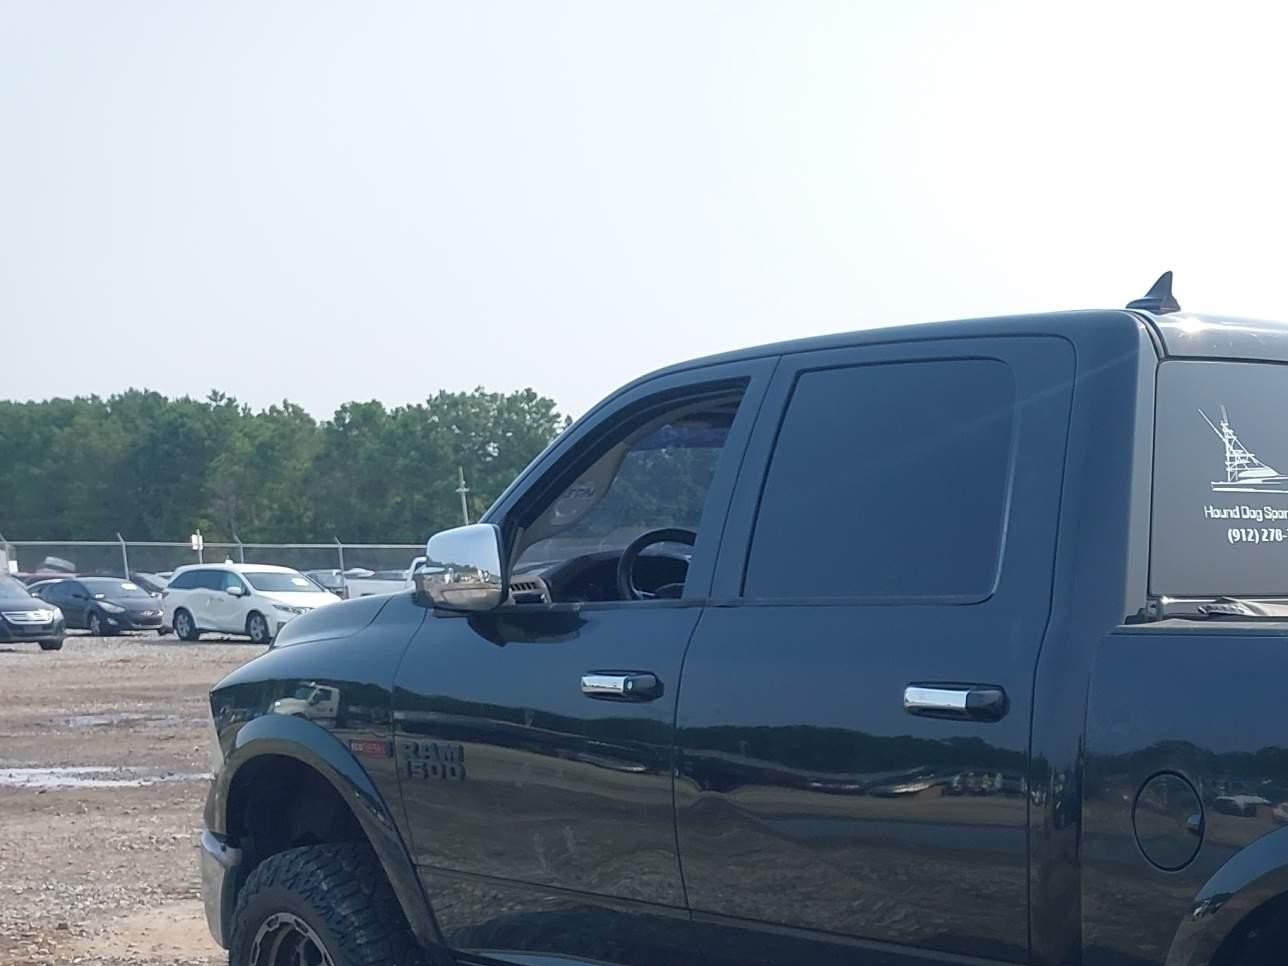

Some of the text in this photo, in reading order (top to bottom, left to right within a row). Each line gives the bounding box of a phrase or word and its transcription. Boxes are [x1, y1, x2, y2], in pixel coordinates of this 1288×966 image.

[1204, 505, 1240, 519] Hound
[1241, 506, 1264, 522] Dog
[1228, 528, 1260, 545] (912)
[401, 742, 464, 762] RAM
[403, 761, 466, 780] 1500
